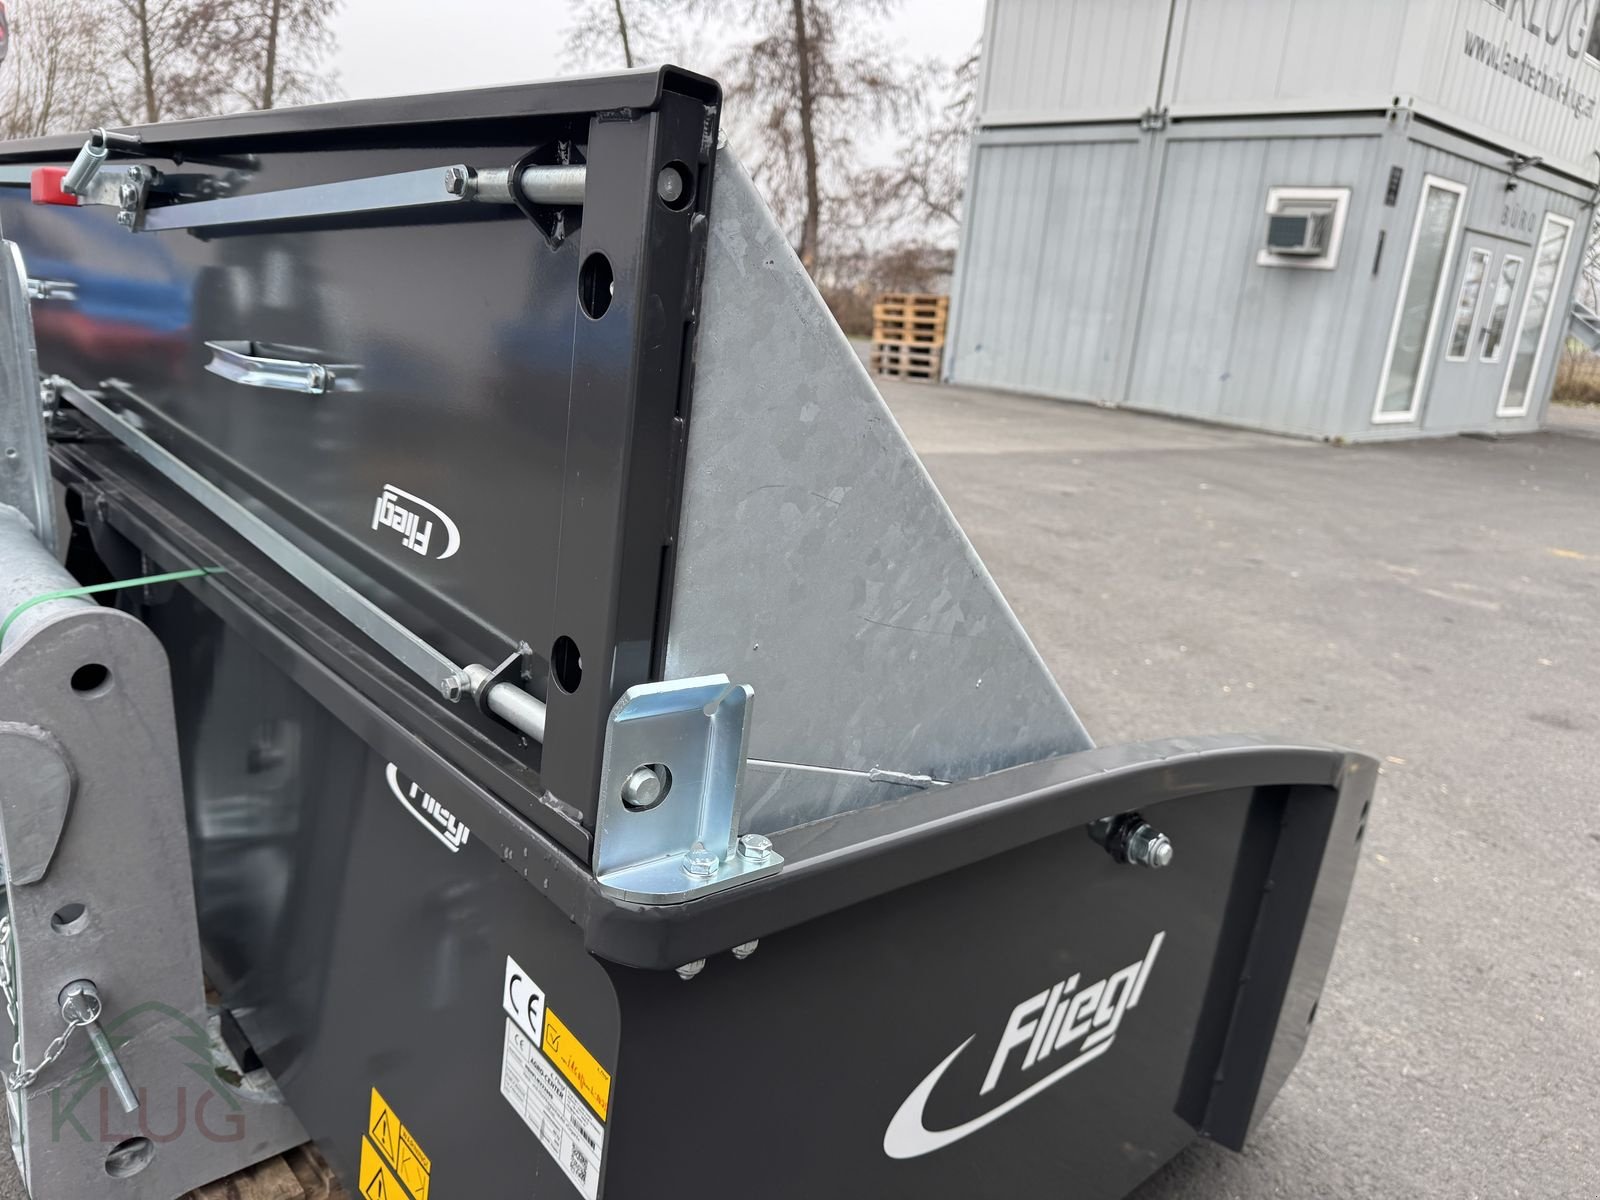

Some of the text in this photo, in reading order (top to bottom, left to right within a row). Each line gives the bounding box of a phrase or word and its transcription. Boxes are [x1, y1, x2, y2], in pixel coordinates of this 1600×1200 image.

[371, 490, 433, 556] Fliegl
[509, 973, 540, 1034] CE
[979, 930, 1166, 1096] Fliegl
